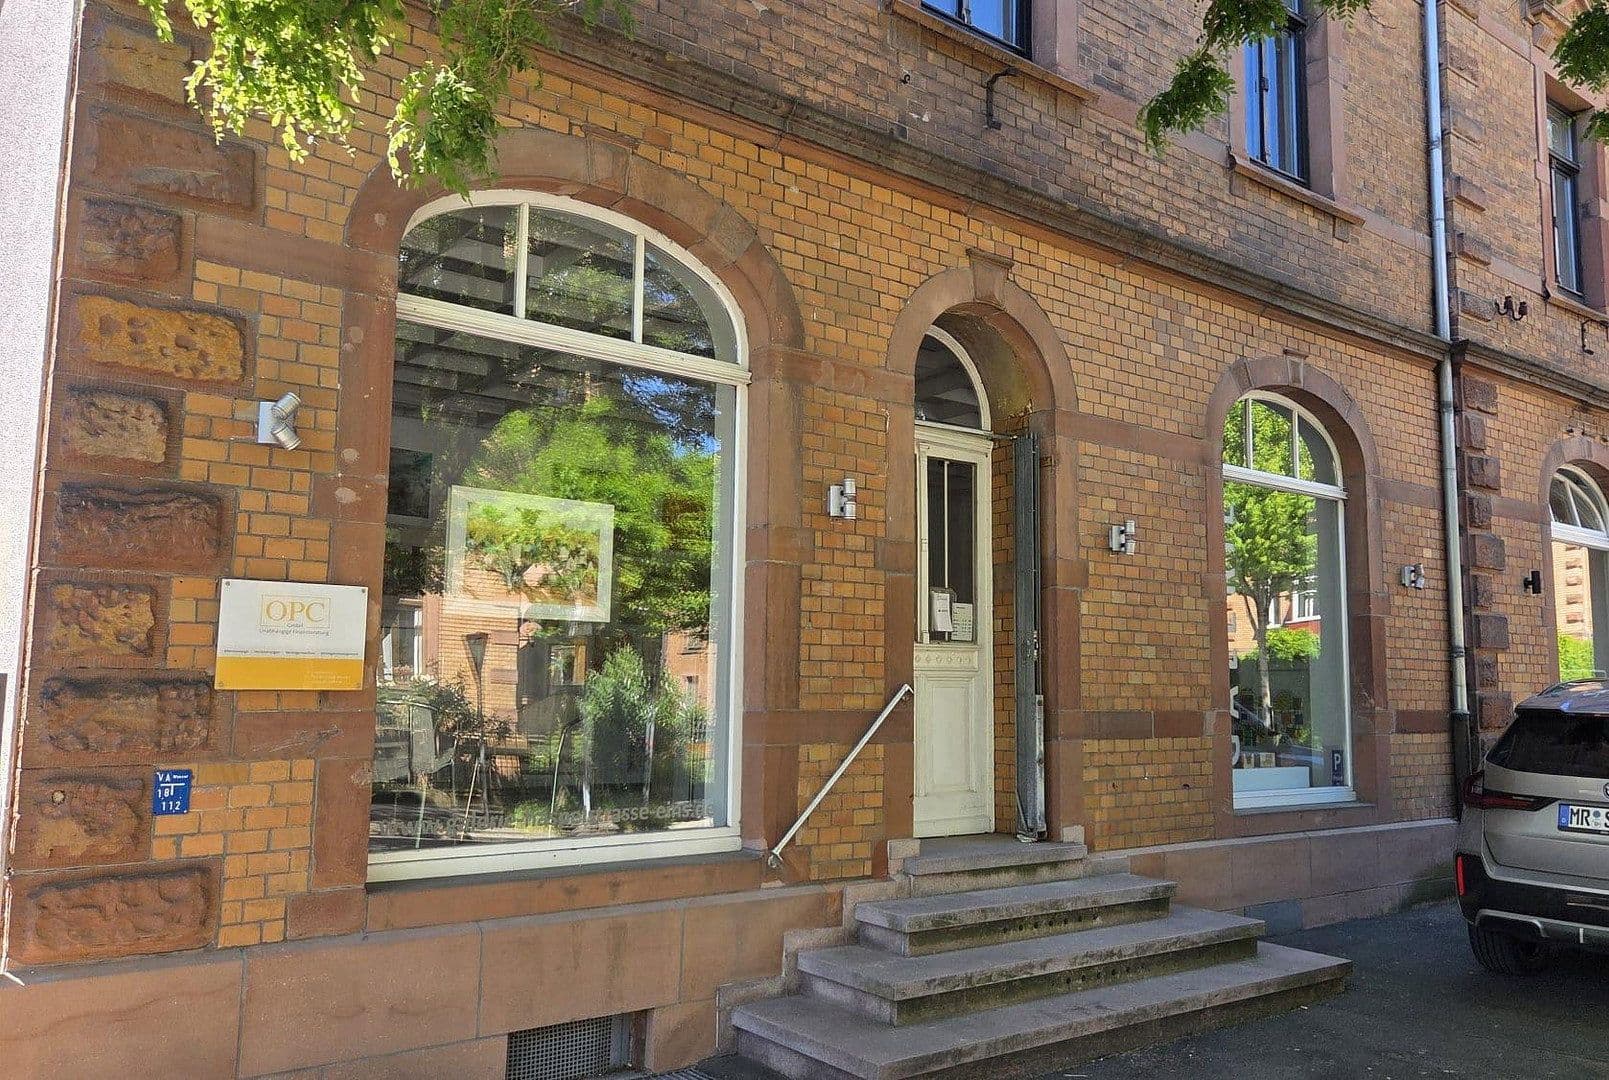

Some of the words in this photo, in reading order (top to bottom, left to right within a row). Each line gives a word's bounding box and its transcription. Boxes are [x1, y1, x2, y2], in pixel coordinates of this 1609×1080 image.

[266, 600, 324, 622] OPC
[1333, 753, 1341, 771] P
[1570, 808, 1590, 826] MR
